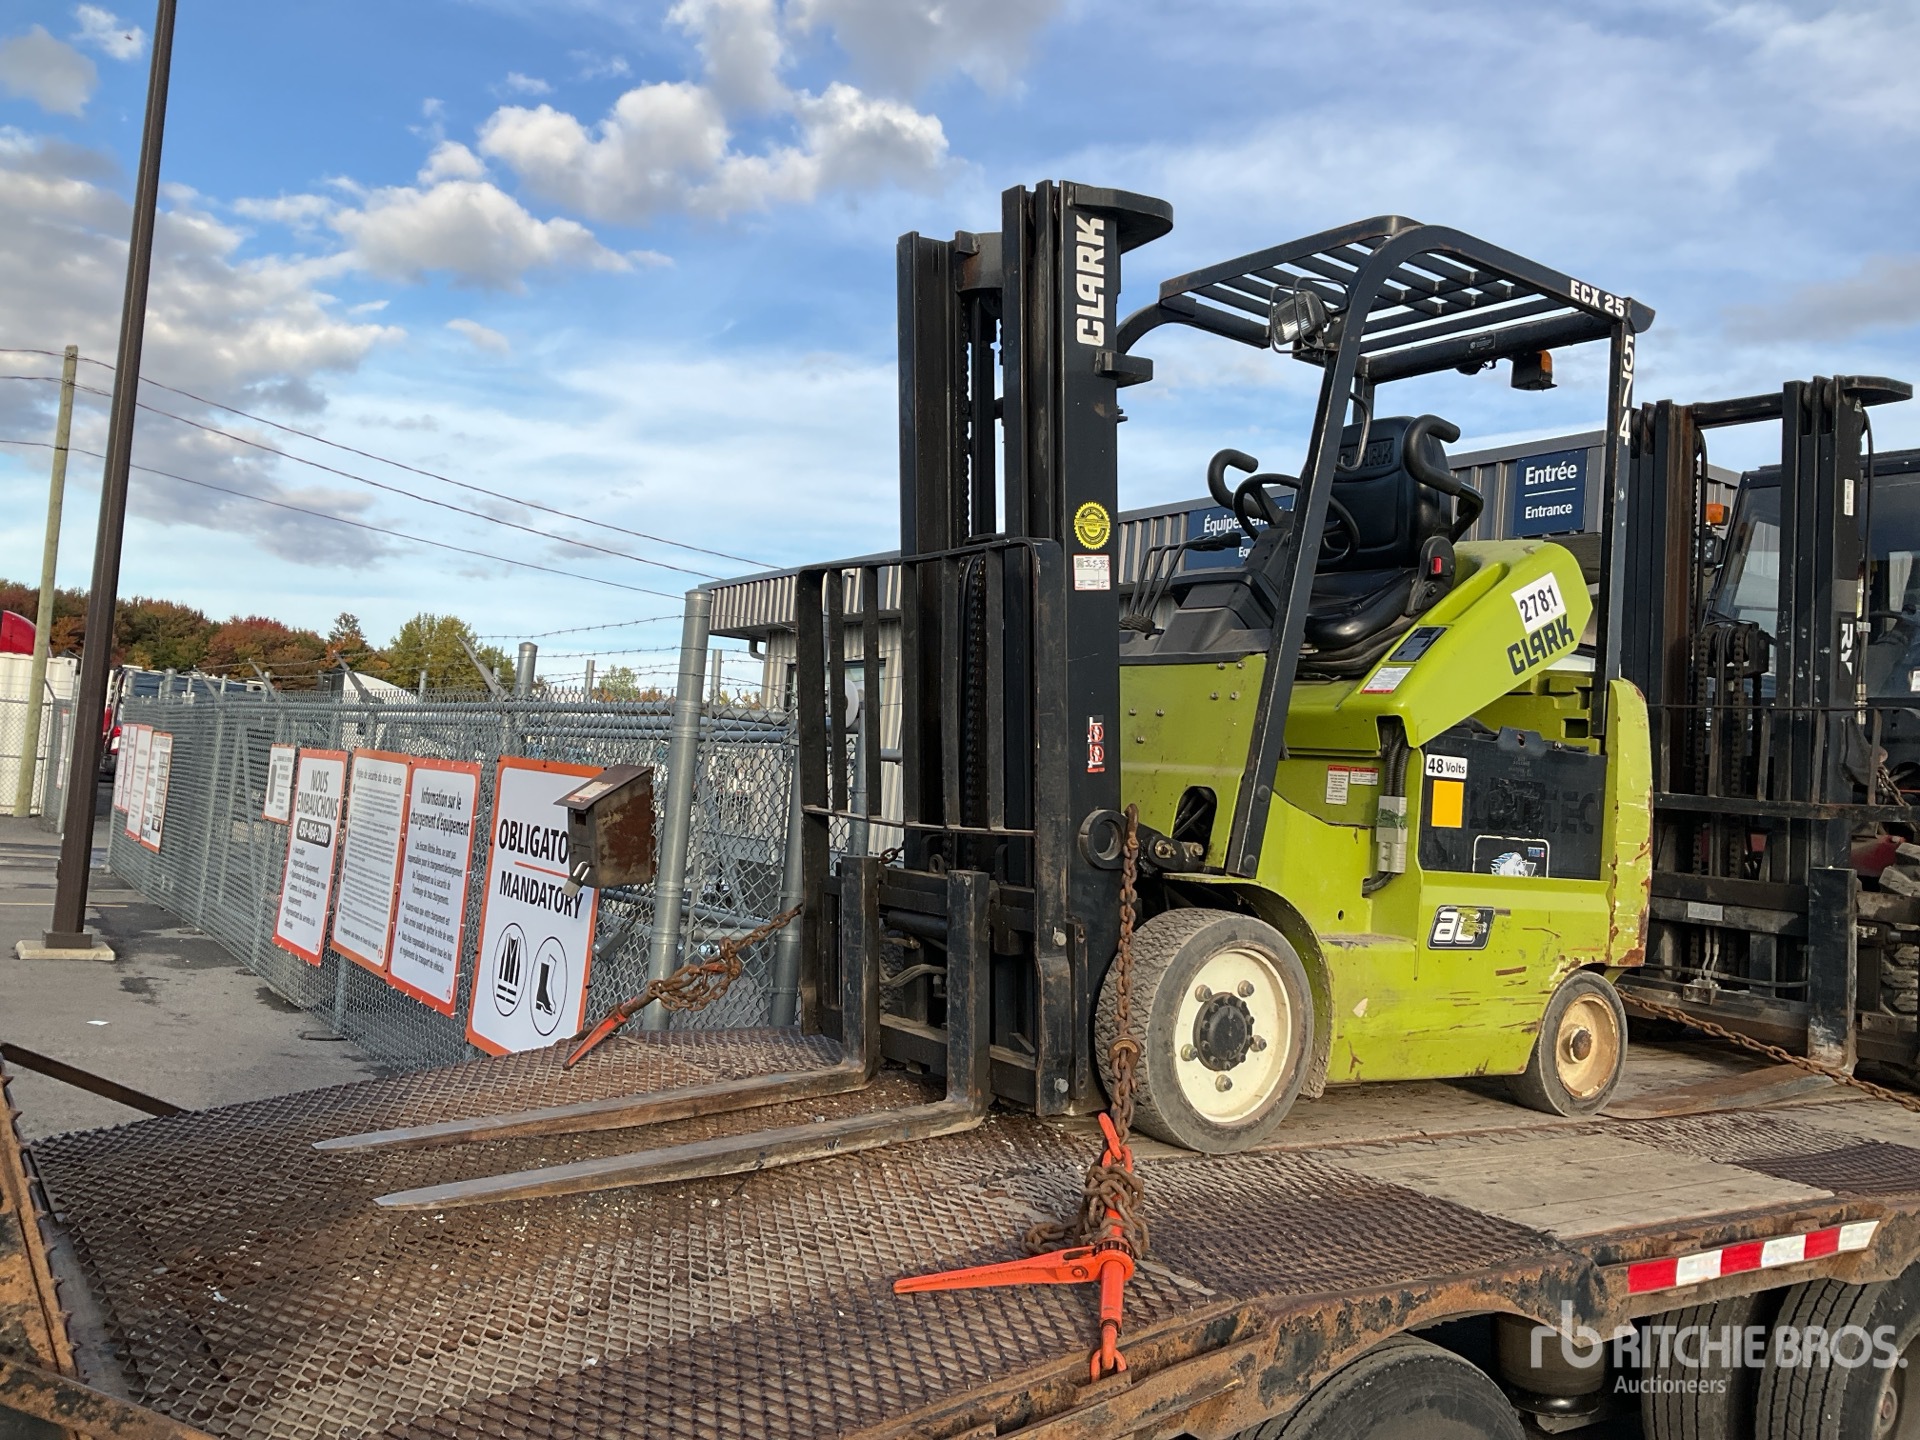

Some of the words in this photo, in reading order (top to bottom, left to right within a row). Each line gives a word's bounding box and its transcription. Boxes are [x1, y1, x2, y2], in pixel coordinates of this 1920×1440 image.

[1076, 214, 1104, 346] CLARK
[1570, 279, 1600, 308] ECX
[1604, 295, 1625, 317] 25
[1525, 461, 1577, 485] Entrée
[1525, 504, 1573, 519] Entrance
[1519, 585, 1558, 623] 2781
[1507, 614, 1575, 675] CLARK
[311, 770, 329, 793] NOUS
[1428, 758, 1444, 774] 48
[1446, 762, 1466, 774] Volts
[499, 818, 570, 865] OBLIGATO
[499, 870, 584, 919] MANDATORY
